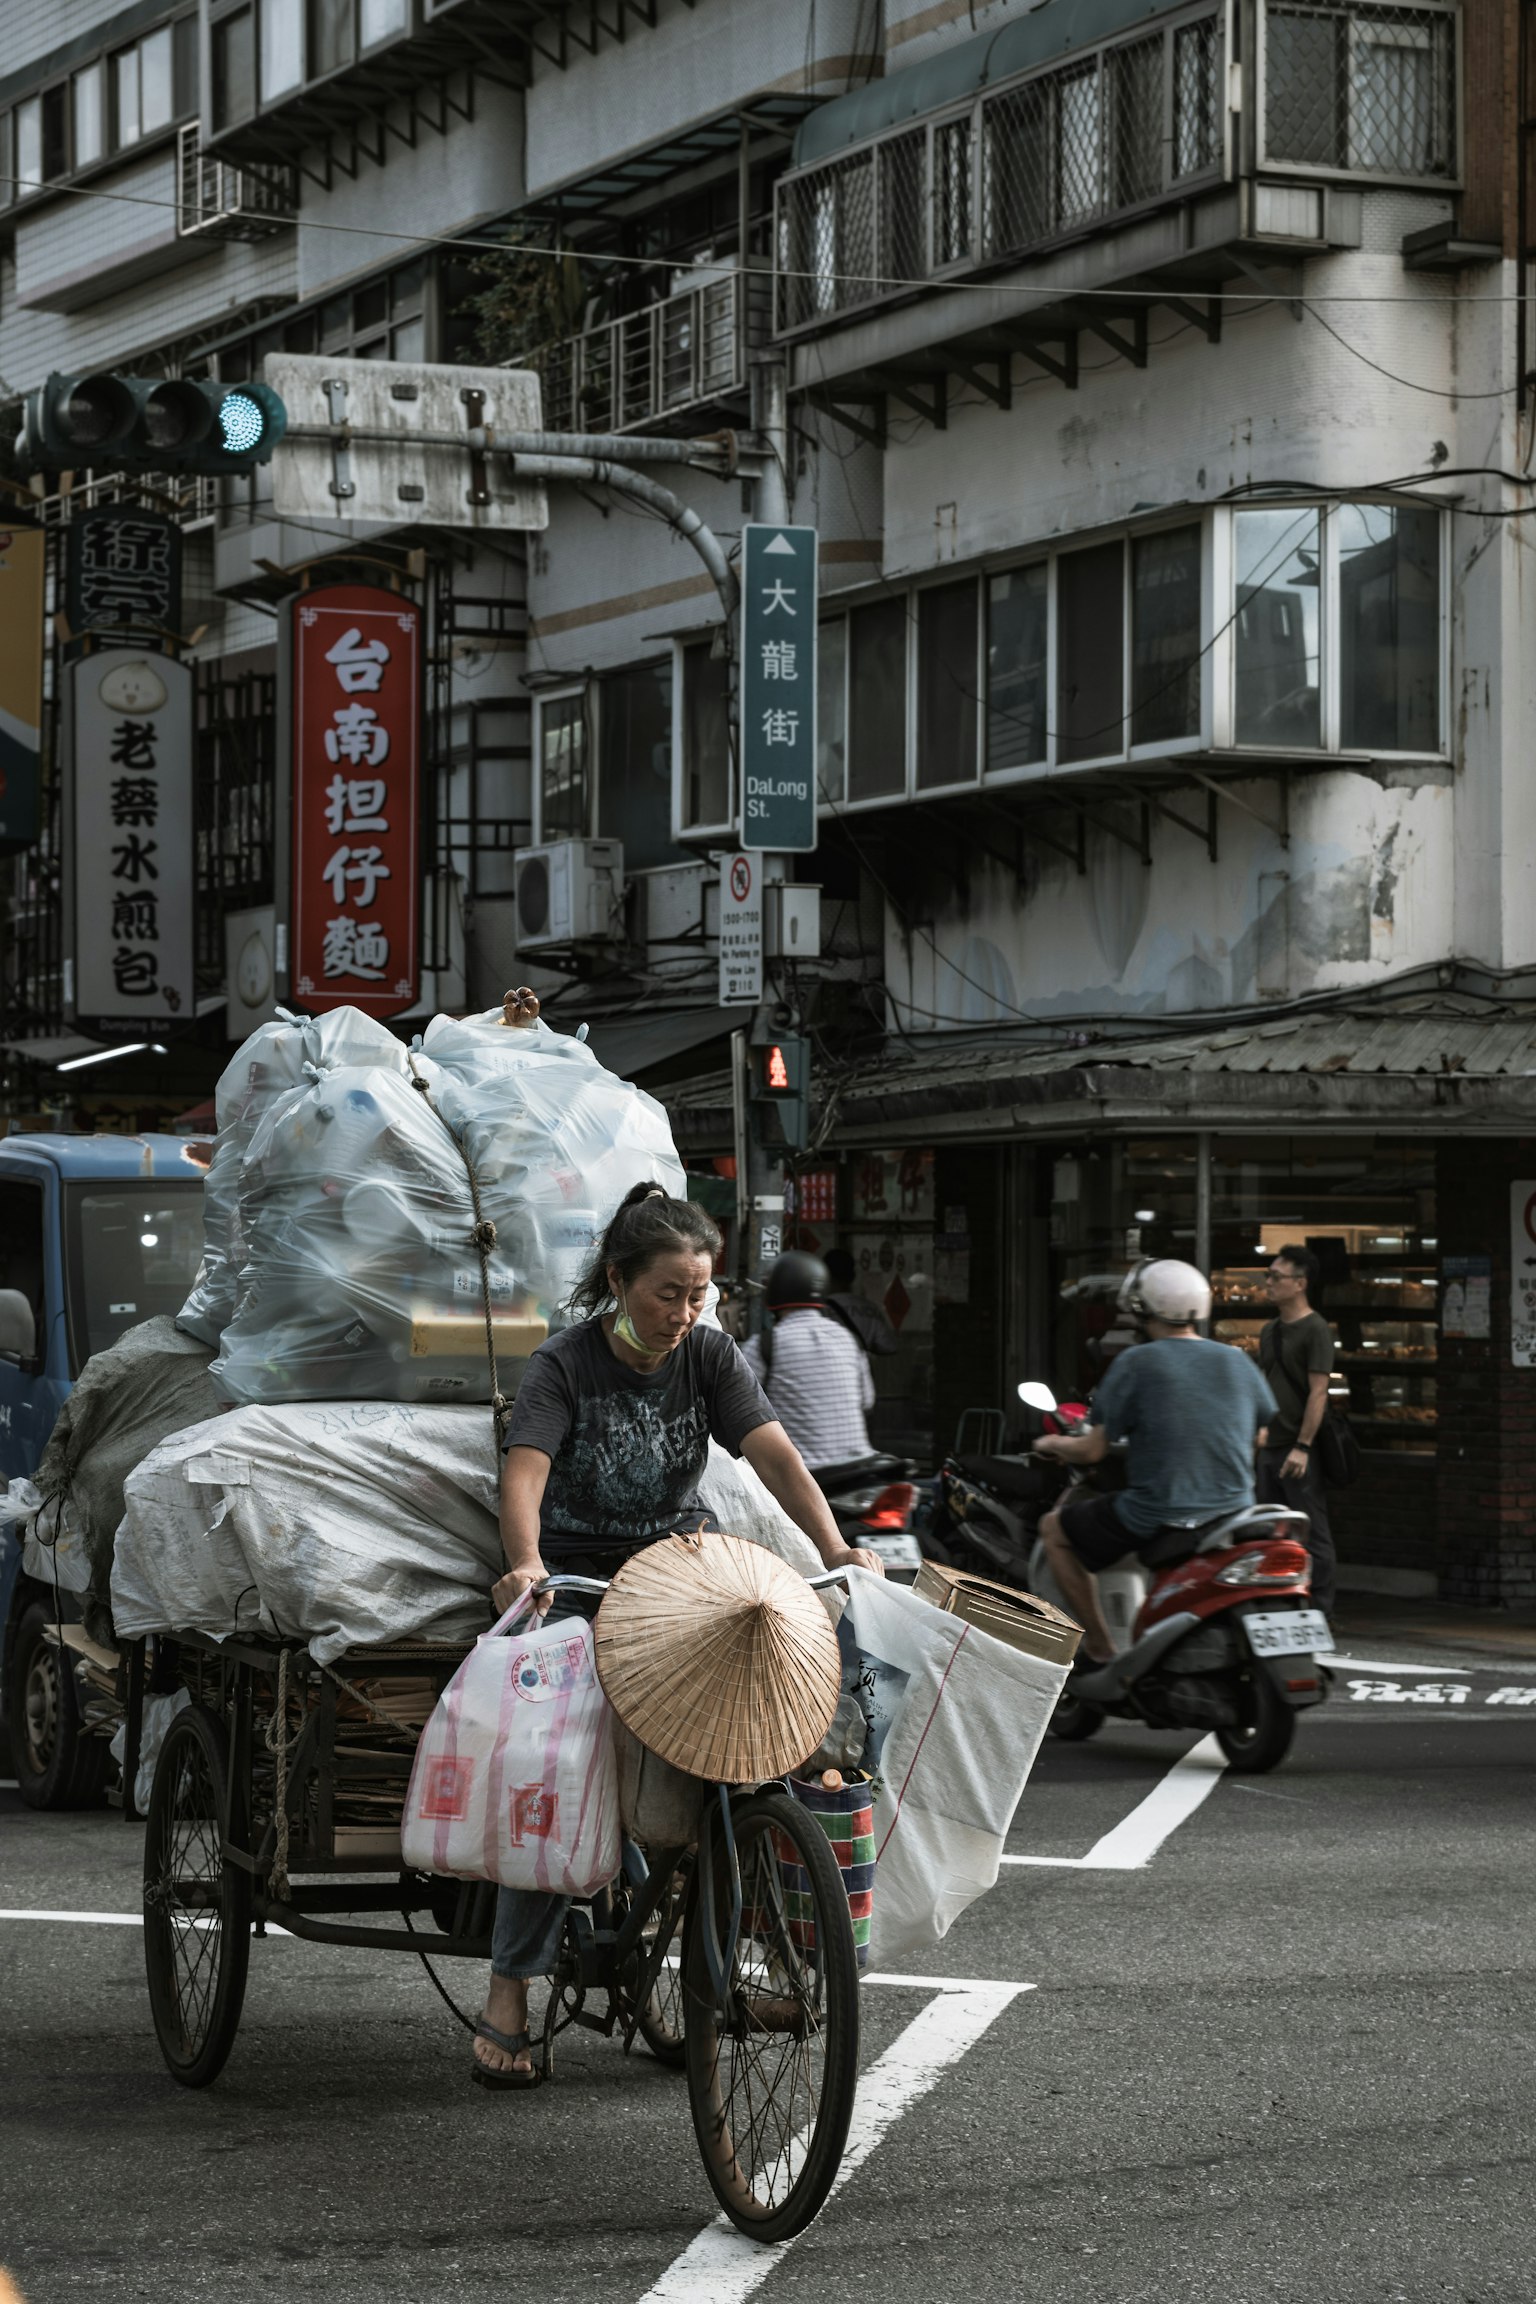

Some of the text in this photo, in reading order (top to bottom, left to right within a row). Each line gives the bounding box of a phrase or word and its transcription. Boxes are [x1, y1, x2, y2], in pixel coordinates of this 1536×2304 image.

[761, 578, 799, 747] 大龍街
[747, 776, 807, 800] DaLong
[323, 627, 391, 981] 台南担仔麵
[747, 799, 770, 819] St.
[109, 719, 160, 998] 老蔡水煎包
[731, 949, 751, 960] Parking
[744, 965, 756, 974] Line
